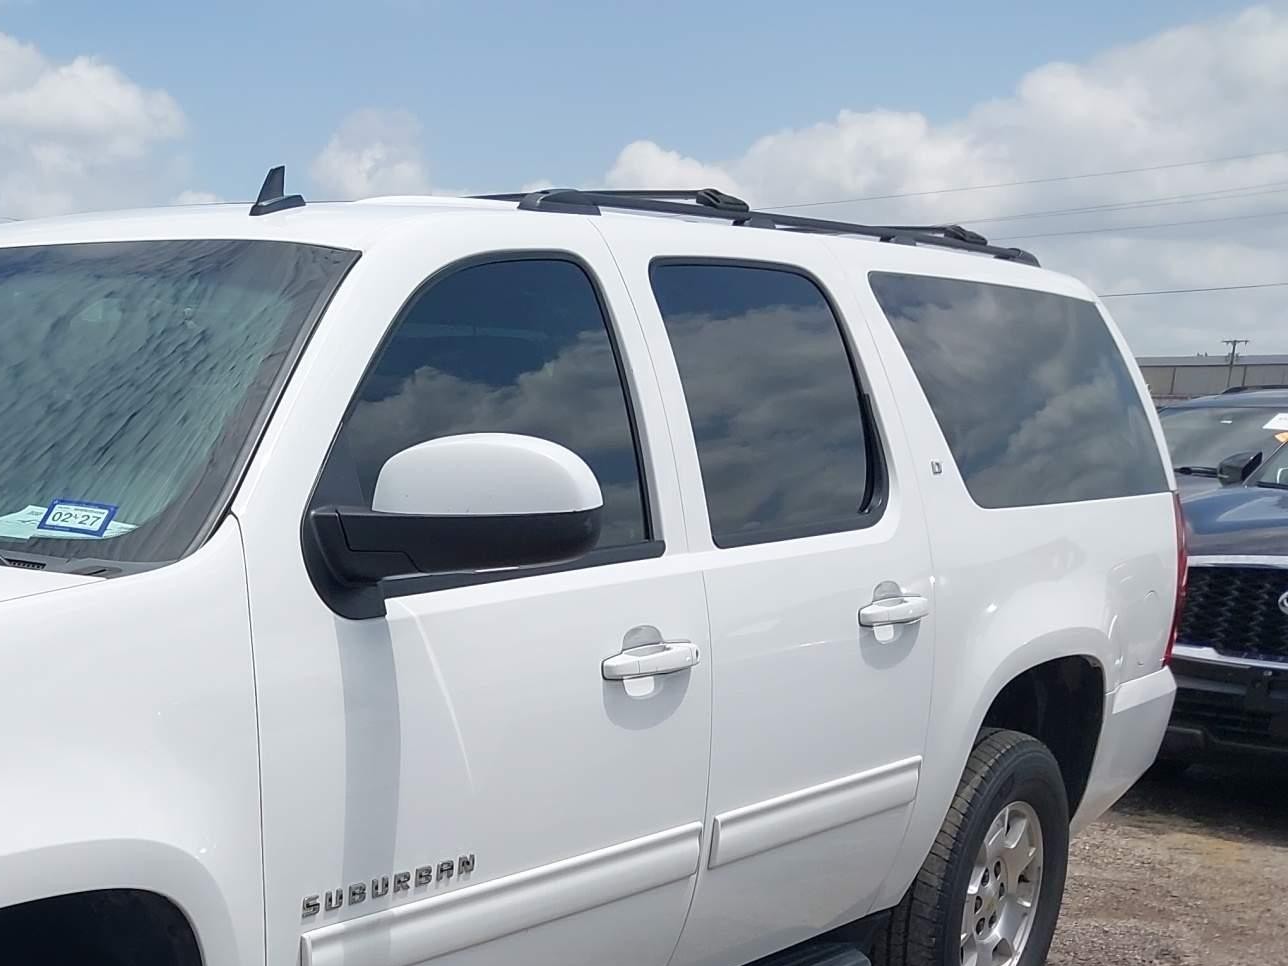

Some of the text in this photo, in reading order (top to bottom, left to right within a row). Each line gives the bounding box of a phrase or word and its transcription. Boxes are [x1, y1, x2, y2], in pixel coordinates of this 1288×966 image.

[51, 511, 73, 523] 02
[78, 514, 102, 527] 27
[301, 853, 477, 918] SUBURBAN
